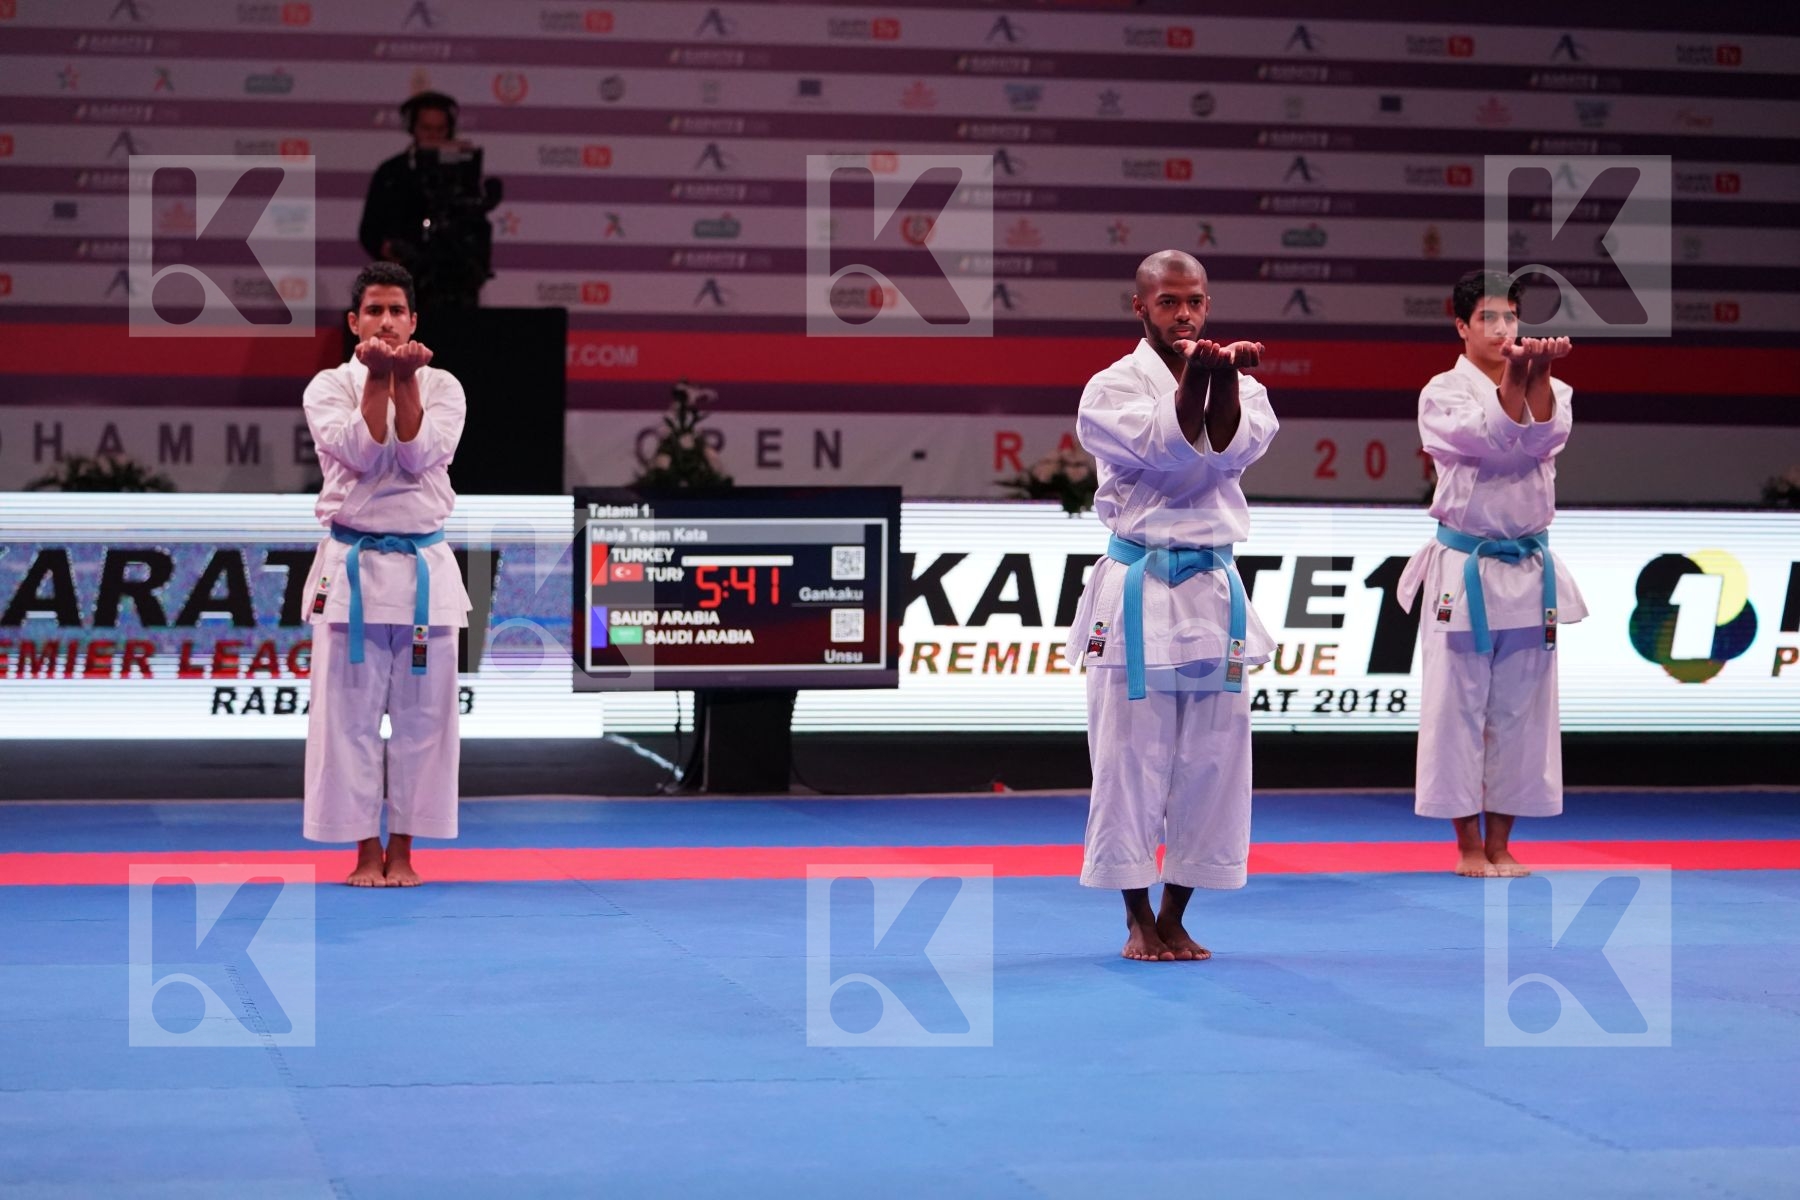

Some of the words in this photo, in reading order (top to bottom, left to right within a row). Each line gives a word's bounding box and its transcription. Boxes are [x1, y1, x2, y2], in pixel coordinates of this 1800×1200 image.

[0, 422, 317, 464] HAMME
[588, 503, 639, 518] Tatami
[642, 503, 650, 518] 1
[592, 528, 627, 543] Male
[630, 528, 671, 543] Team
[673, 528, 708, 543] Kata
[611, 548, 675, 563] TURKEY
[696, 566, 780, 608] 5:41
[799, 587, 864, 602] Gankaku
[610, 610, 659, 625] SAUDI
[661, 610, 720, 625] ARABIA
[645, 630, 693, 645] SAUDI
[695, 629, 755, 645] ARABIA
[824, 649, 864, 663] Unsu
[211, 686, 310, 715] RAB
[1312, 689, 1407, 713] 2018
